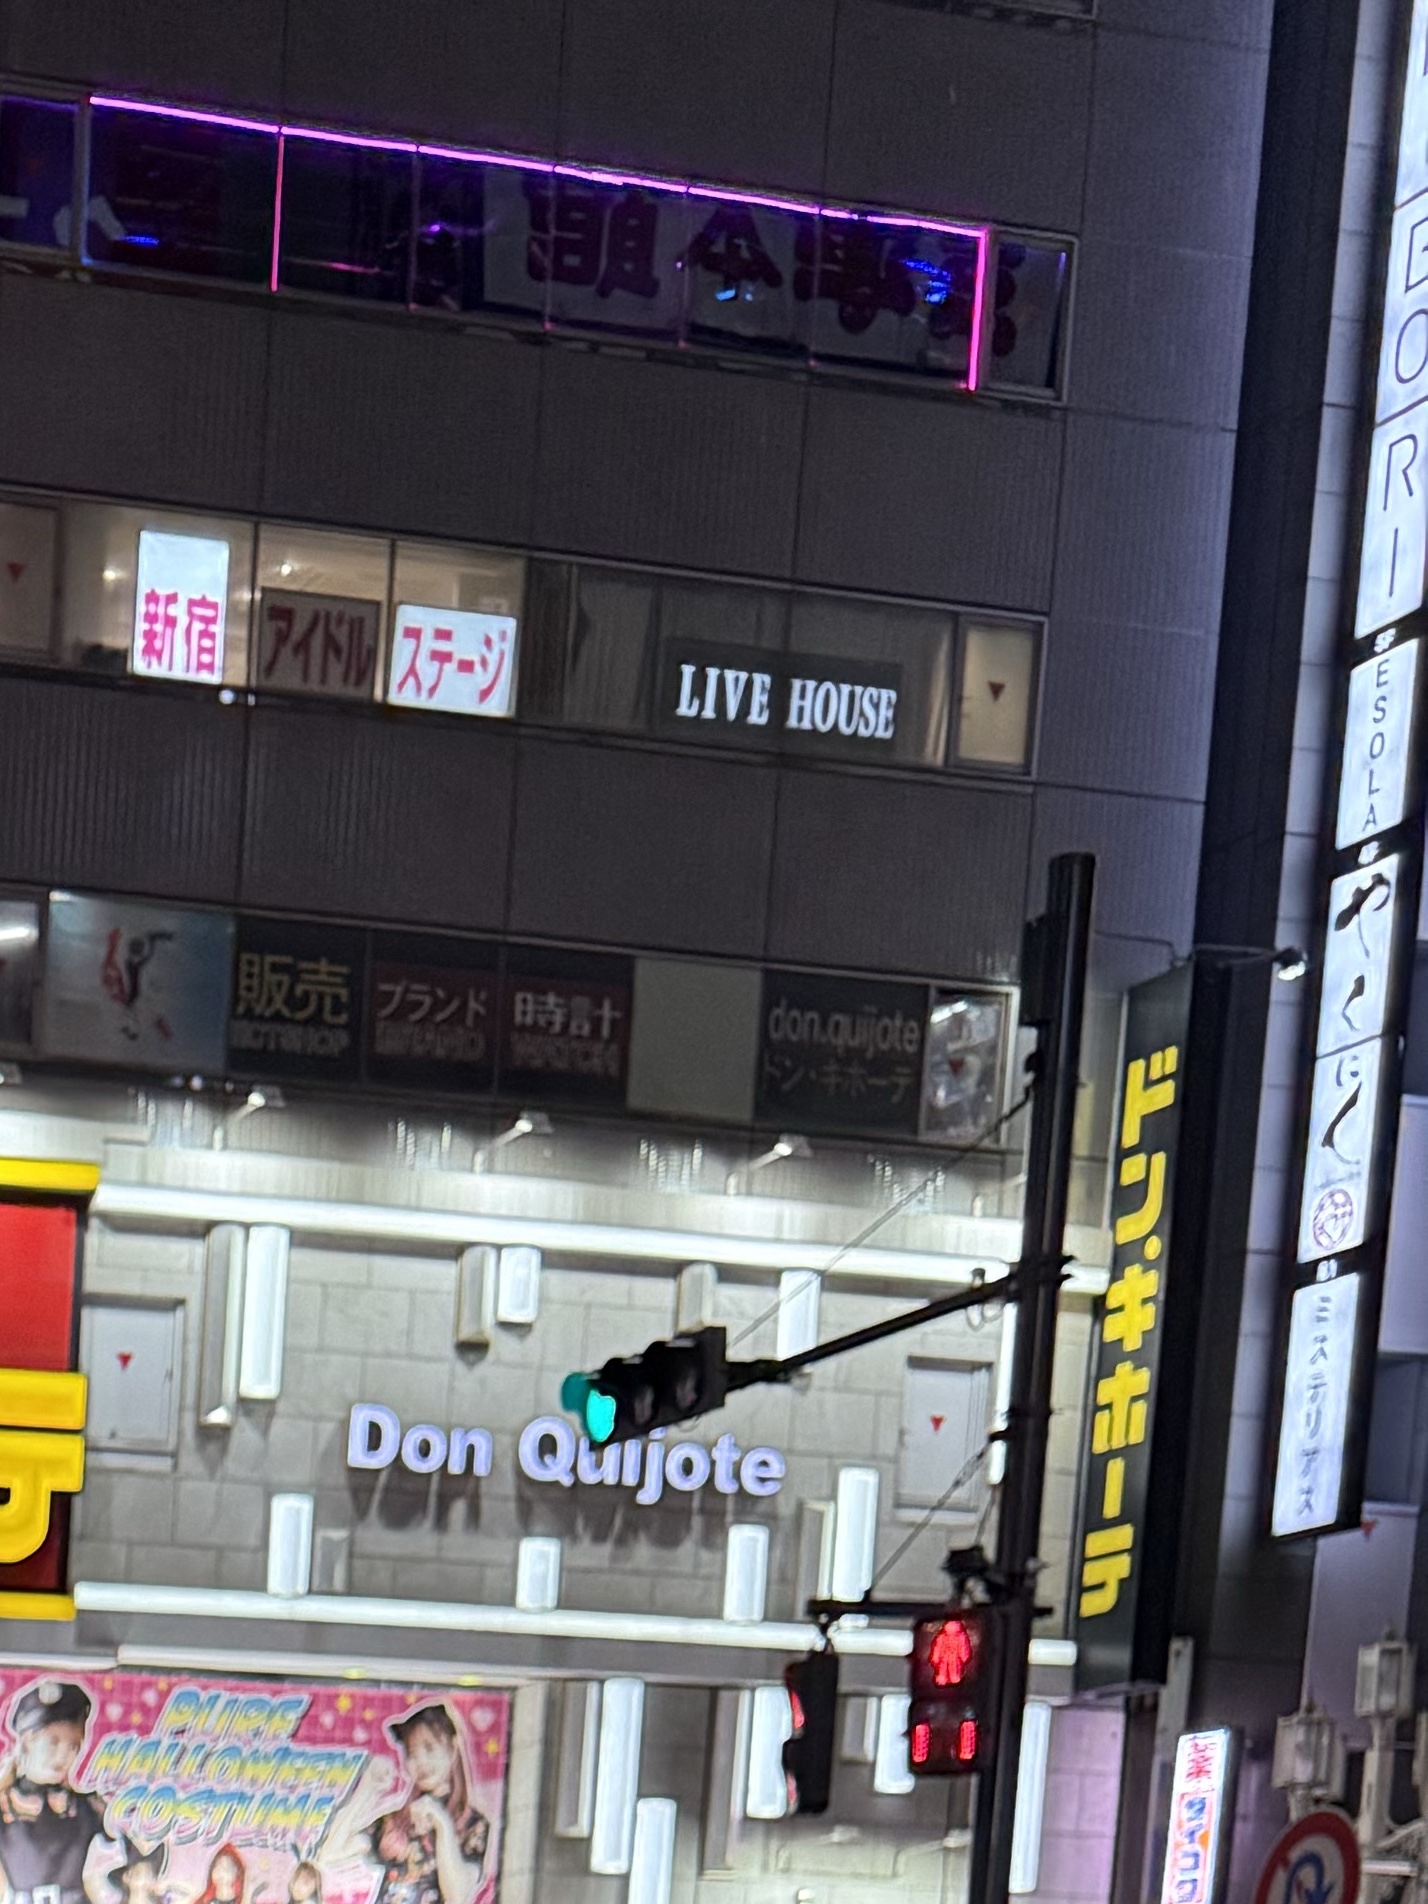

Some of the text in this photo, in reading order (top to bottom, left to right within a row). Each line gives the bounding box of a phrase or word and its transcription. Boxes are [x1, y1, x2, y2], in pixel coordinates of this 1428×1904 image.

[141, 588, 511, 704] 新宿 アイドル ステージ
[676, 662, 898, 740] LIVE HOUSE
[1361, 658, 1392, 831] ESOLA
[235, 952, 349, 1025] 販売
[377, 980, 487, 1028] ブランド
[513, 990, 623, 1041] 時計
[346, 1403, 786, 1506] Don Quijote
[157, 1688, 309, 1740] PURE
[89, 1733, 370, 1801] HALLOWEEN
[107, 1782, 336, 1846] COSTUME
